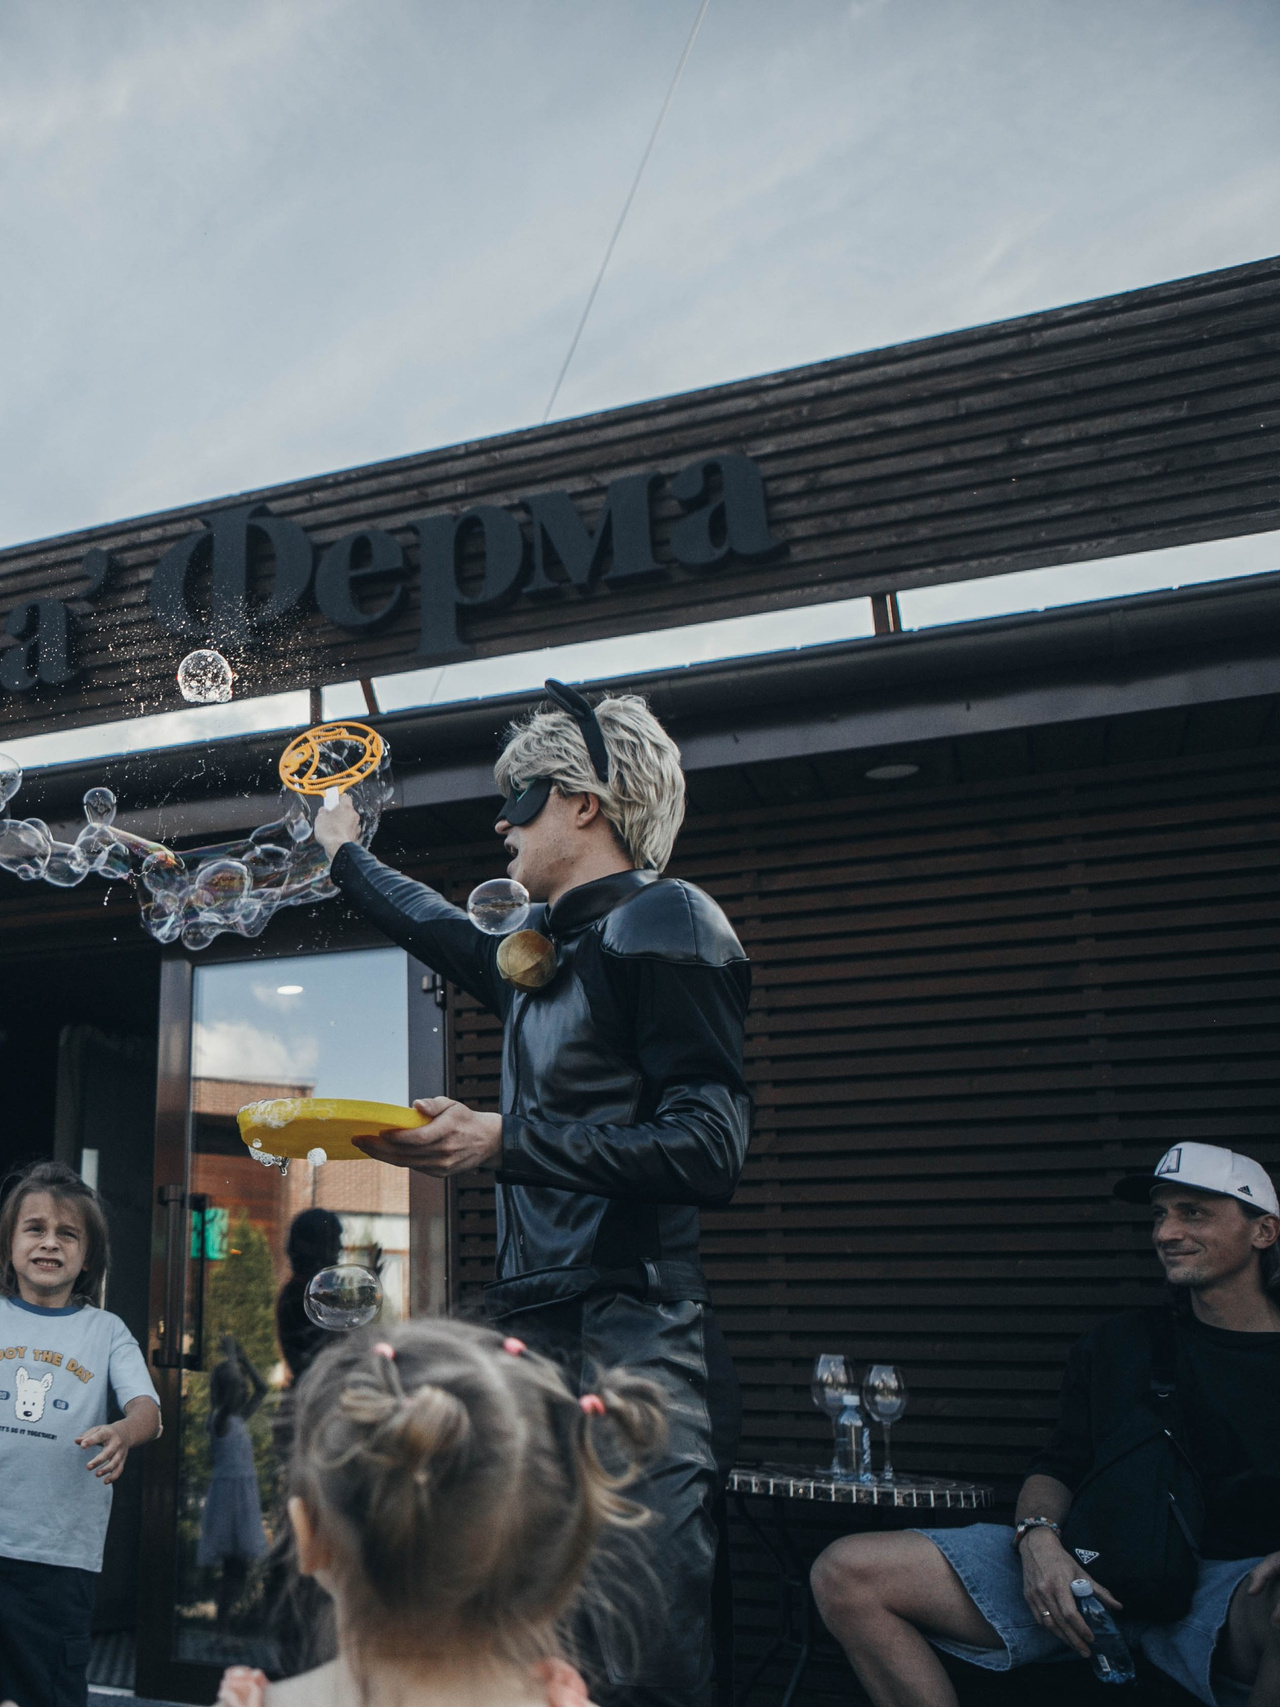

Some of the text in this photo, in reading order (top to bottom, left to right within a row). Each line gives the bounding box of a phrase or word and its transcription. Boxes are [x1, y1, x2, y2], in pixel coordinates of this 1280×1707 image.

[150, 452, 783, 656] Ферма
[33, 1349, 64, 1367] THE
[66, 1358, 94, 1384] DAY
